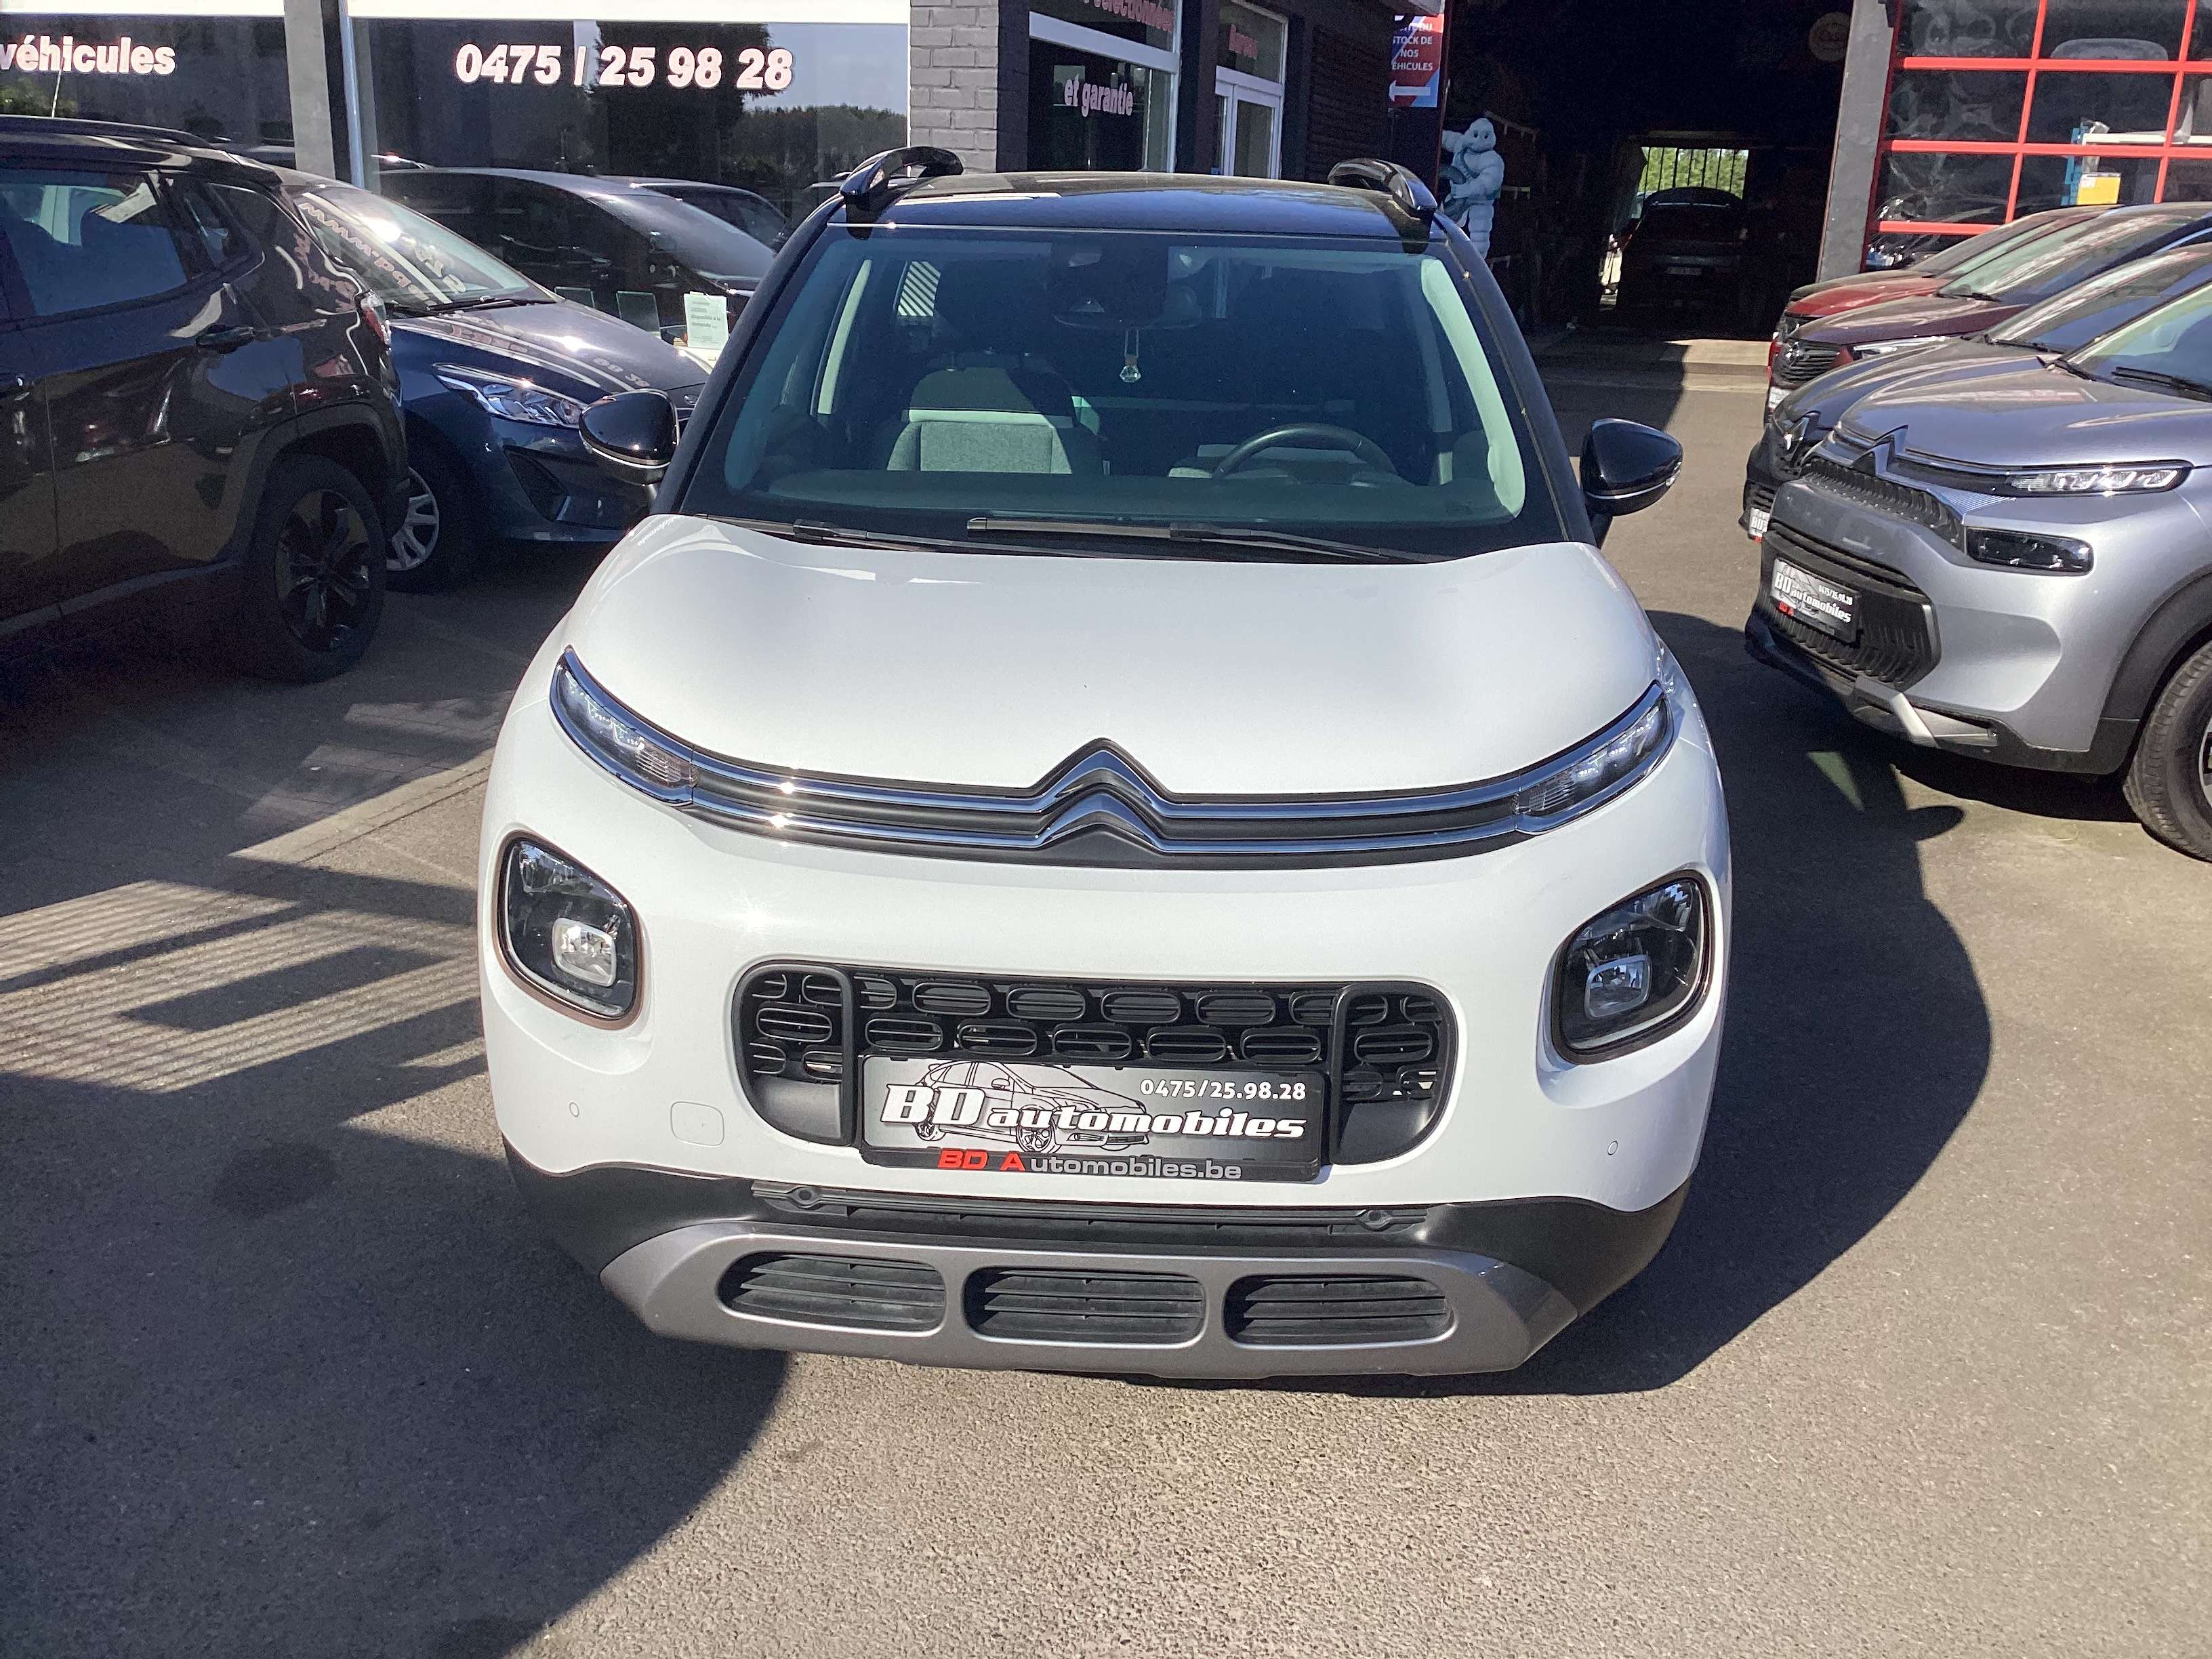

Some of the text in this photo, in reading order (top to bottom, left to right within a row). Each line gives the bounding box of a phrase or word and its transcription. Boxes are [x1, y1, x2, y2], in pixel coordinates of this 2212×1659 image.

[0, 35, 176, 75] véhicules
[1400, 49, 1419, 58] NOS
[1420, 36, 1433, 45] DE
[455, 43, 562, 84] 0475
[598, 45, 656, 86] 25
[667, 47, 722, 88] 98
[736, 48, 794, 89] 28
[1065, 73, 1134, 117] et garantie
[1790, 589, 1852, 623] automobiles
[1140, 1078, 1307, 1101] 0475/25.98.28
[880, 1084, 1307, 1139] BD automobiles
[937, 1147, 989, 1170] BD
